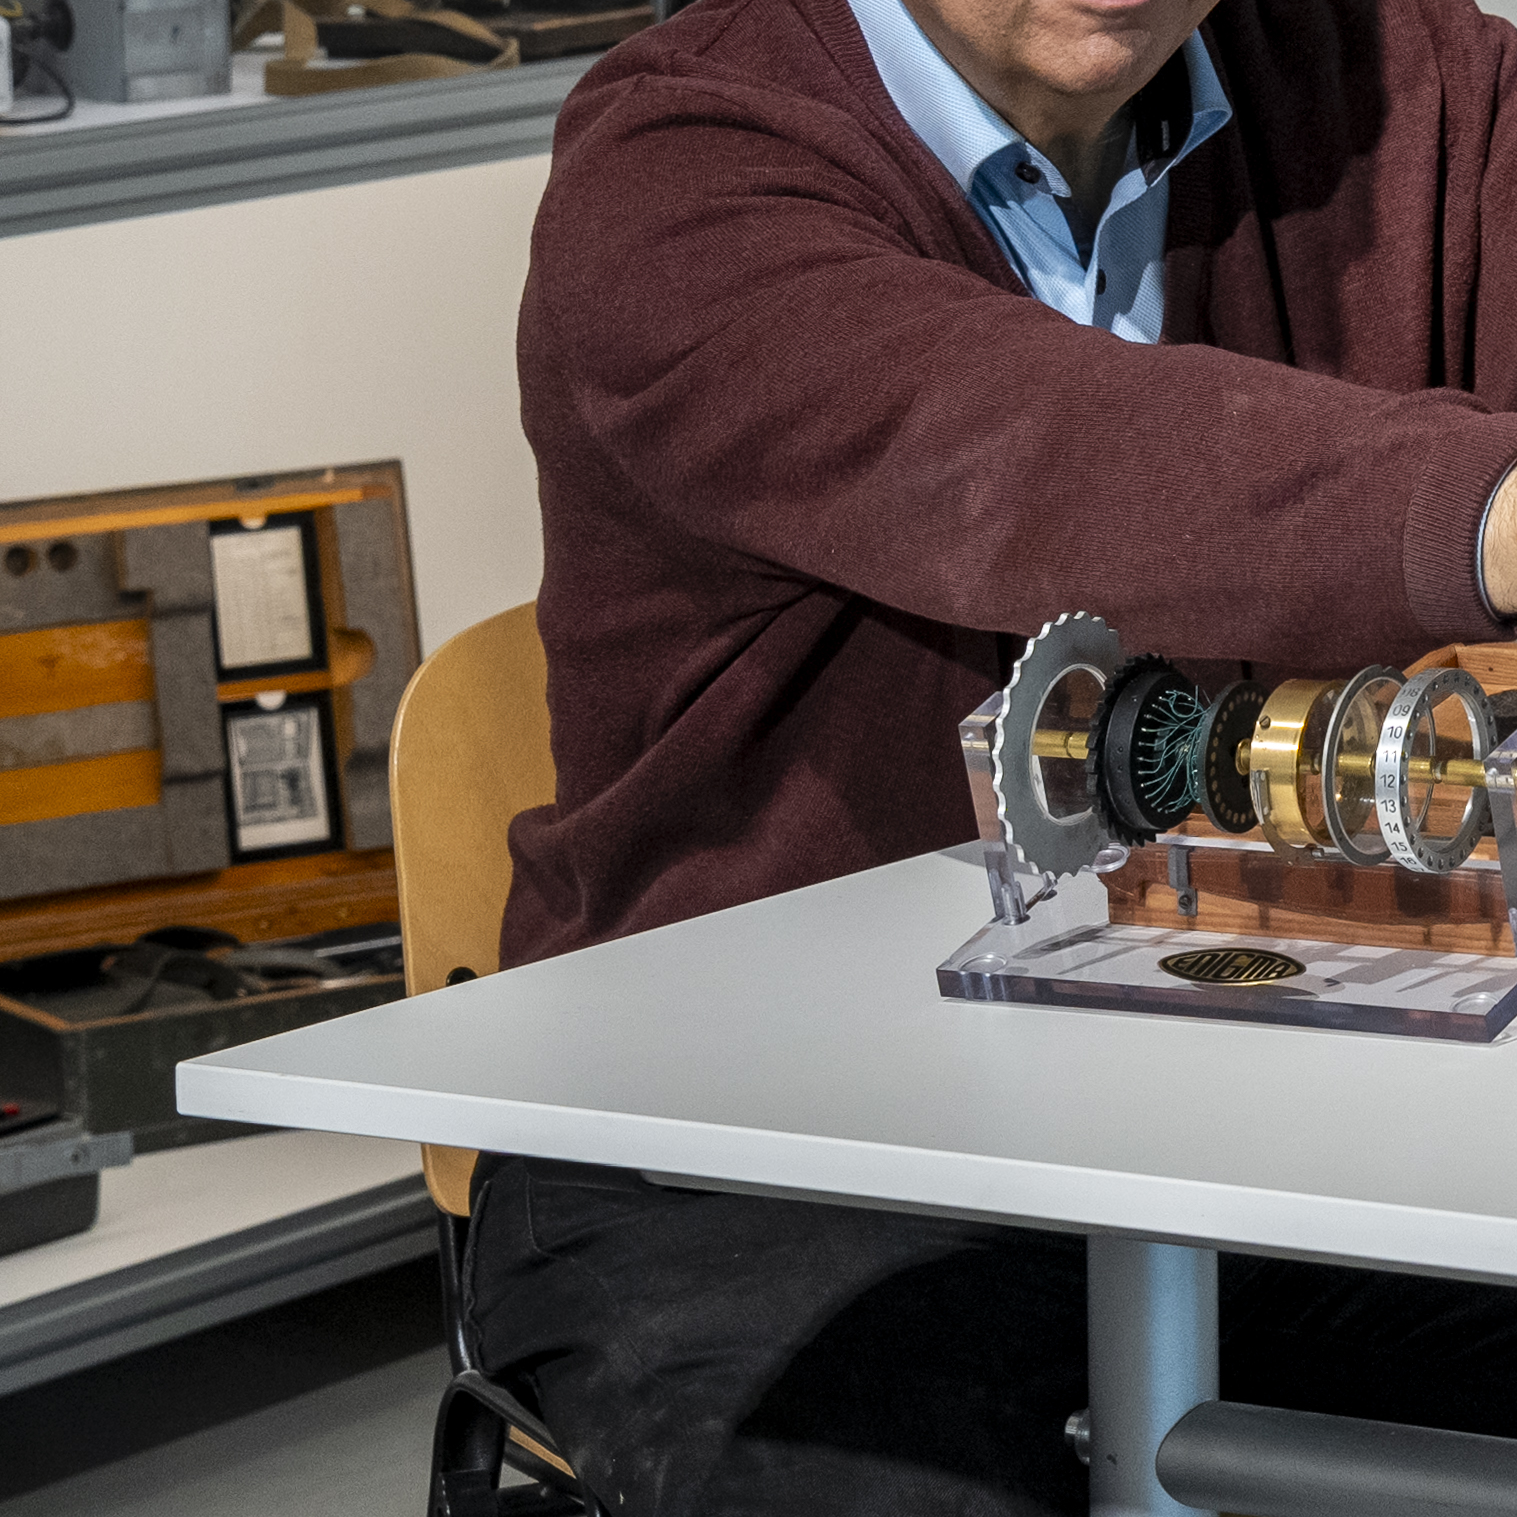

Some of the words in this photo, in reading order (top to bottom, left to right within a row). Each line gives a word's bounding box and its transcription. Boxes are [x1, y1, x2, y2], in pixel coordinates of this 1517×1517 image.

[1393, 705, 1411, 716] 09
[1387, 726, 1403, 739] 10
[1383, 750, 1397, 763] 11
[1380, 774, 1395, 788] 12
[1380, 799, 1397, 813] 13
[1385, 822, 1400, 834] 14
[1391, 842, 1408, 852] 15
[1173, 950, 1292, 979] ENIGMA
